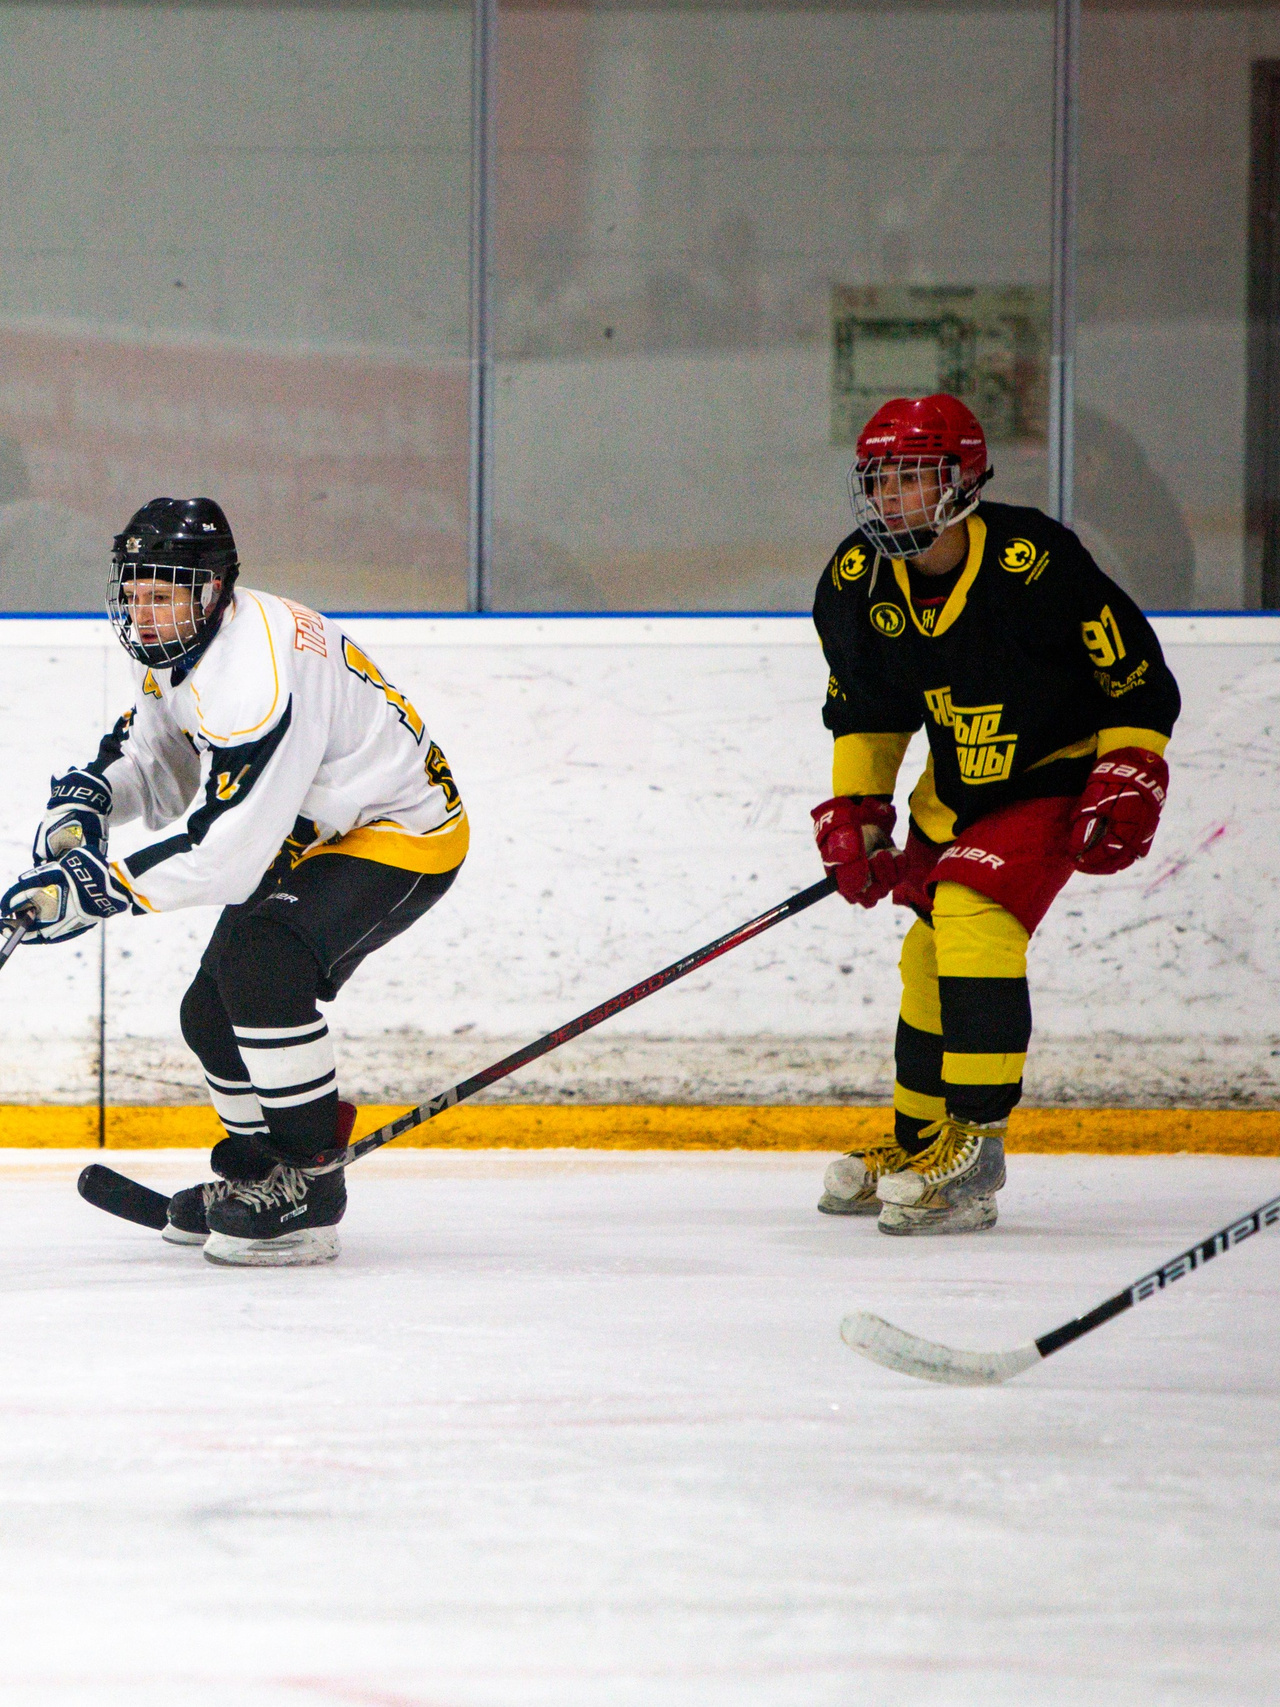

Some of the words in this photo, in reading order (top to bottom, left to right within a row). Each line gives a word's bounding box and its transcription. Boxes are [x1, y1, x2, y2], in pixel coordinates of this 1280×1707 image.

[52, 785, 107, 807] AUER
[66, 855, 119, 918] BAUER
[937, 846, 1006, 871] AUER
[546, 972, 665, 1051] JETSPEED
[346, 1085, 458, 1163] CCM
